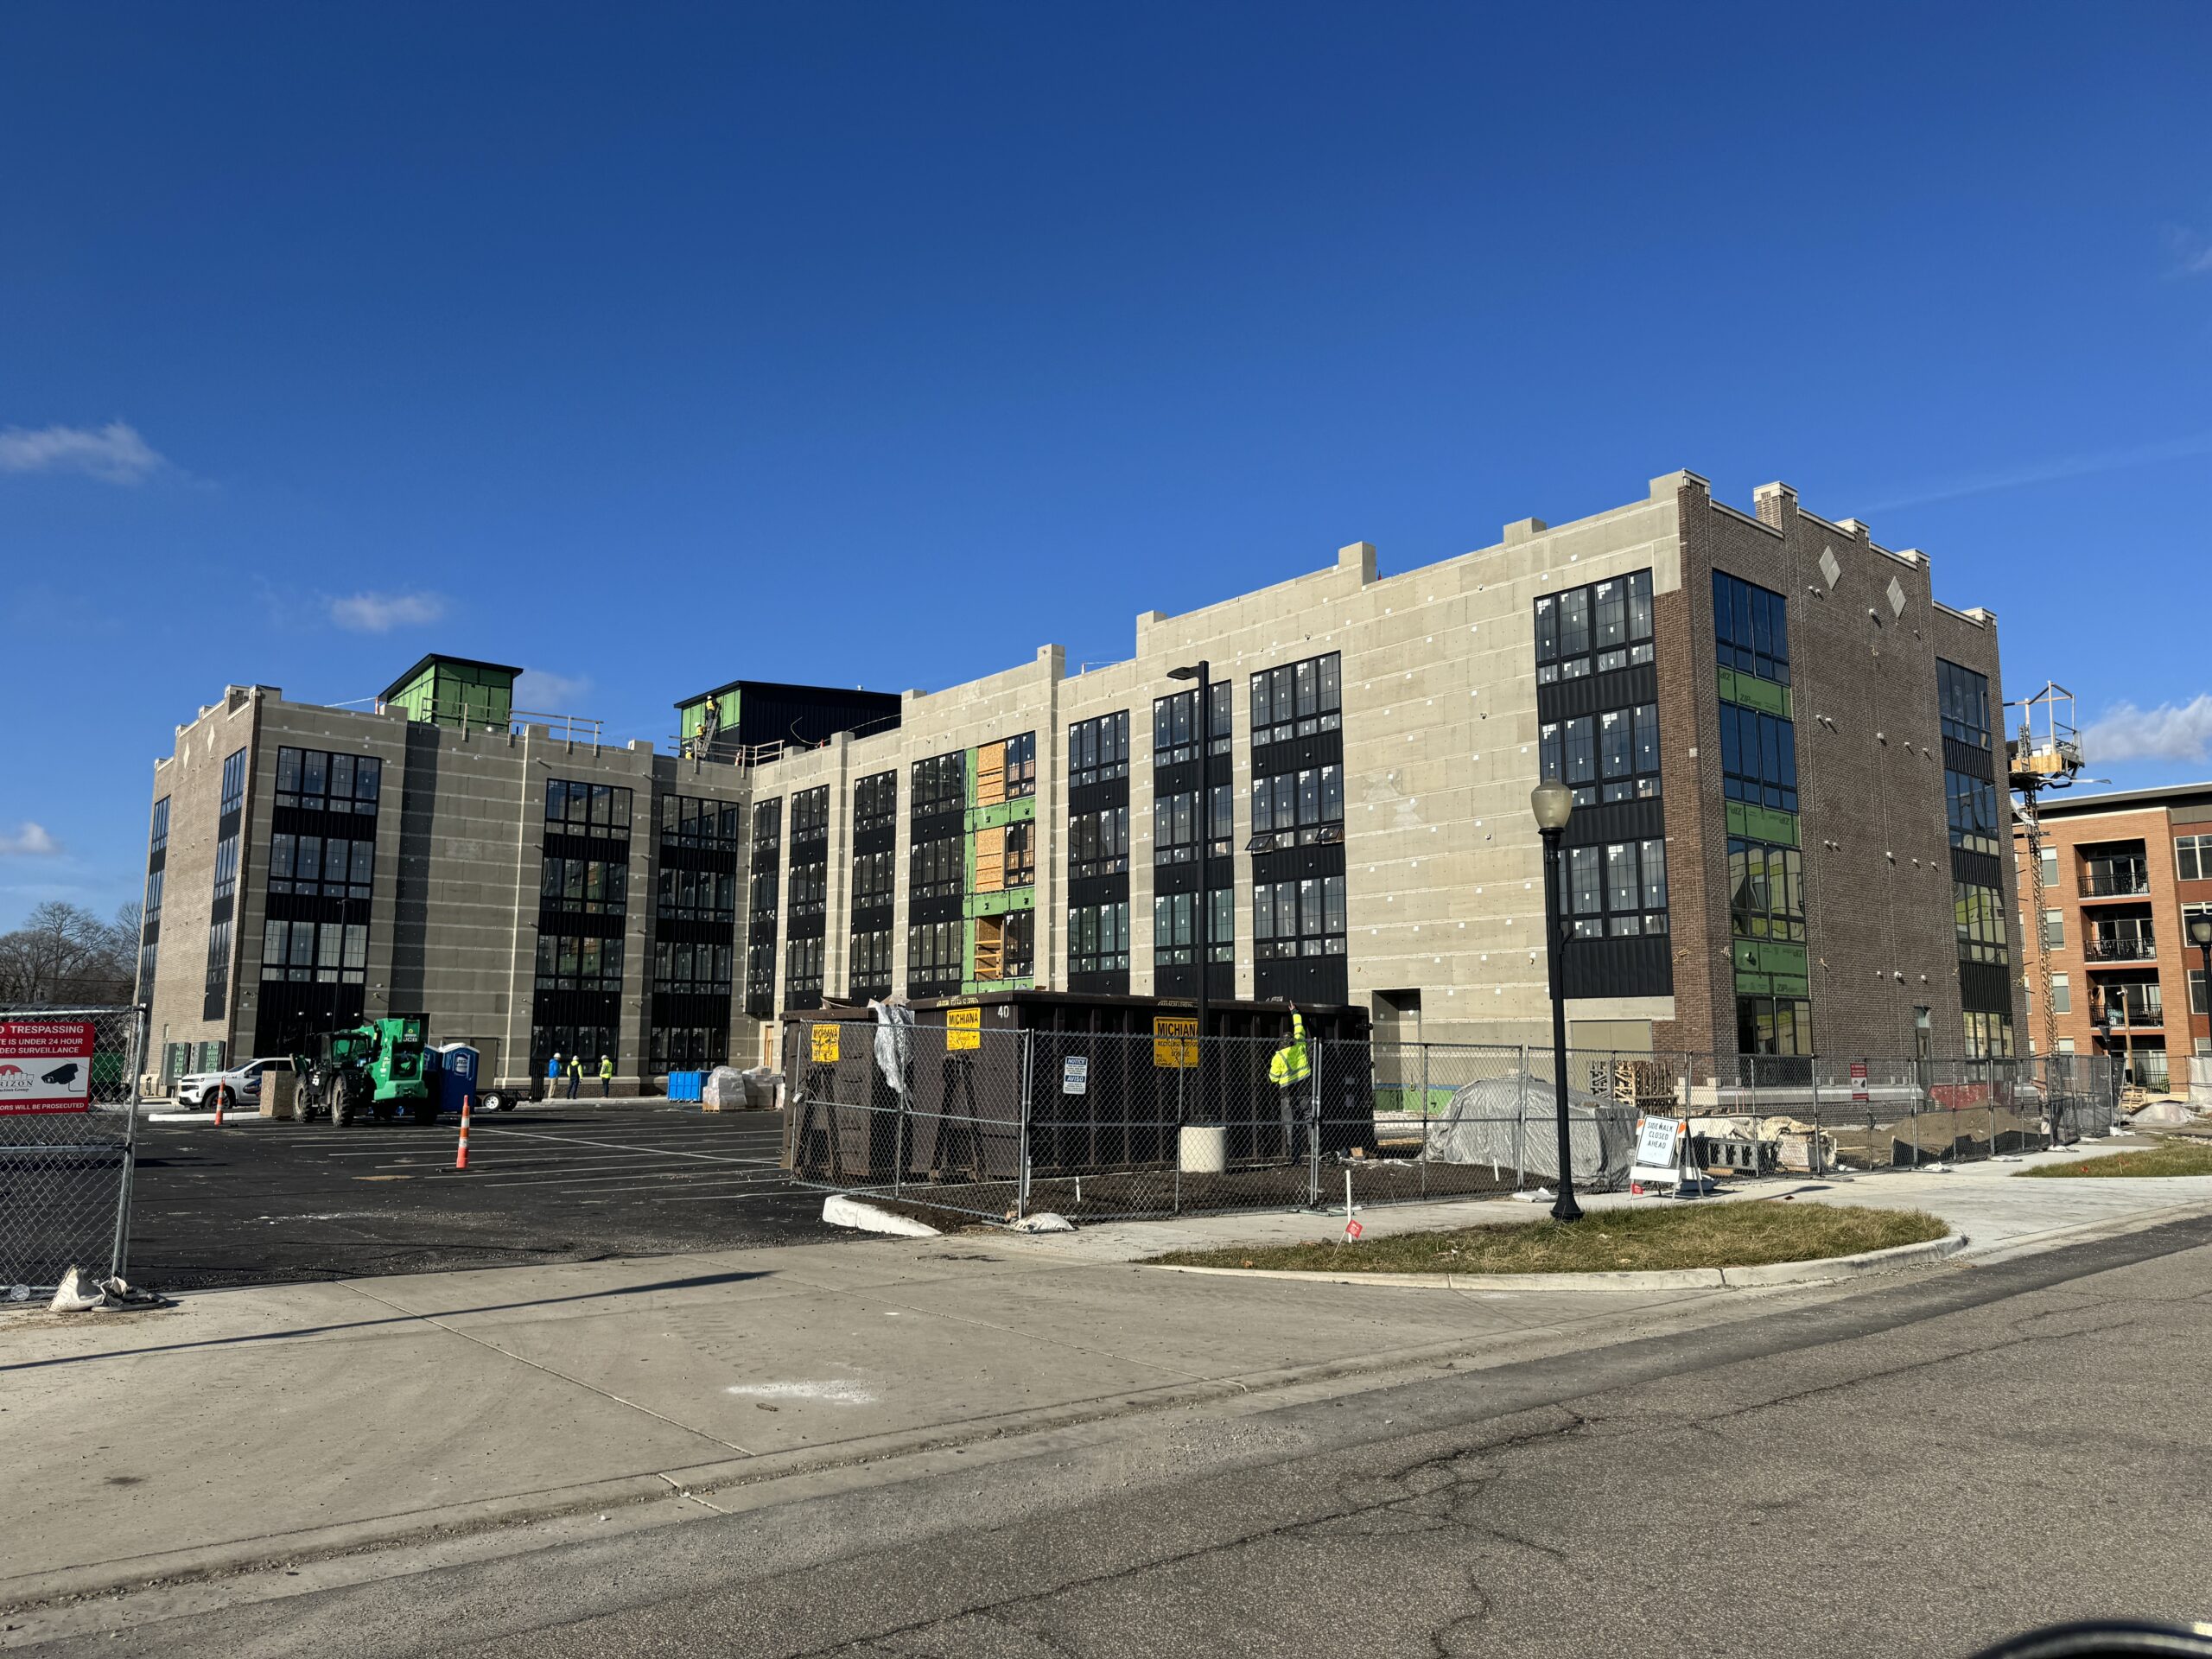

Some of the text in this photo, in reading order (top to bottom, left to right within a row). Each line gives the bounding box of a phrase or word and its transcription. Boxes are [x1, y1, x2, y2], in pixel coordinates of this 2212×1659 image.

[997, 1005, 1009, 1019] 40
[1158, 1022, 1198, 1037] MICHIAN
[1647, 1122, 1673, 1132] SIDEWALK
[1649, 1131, 1669, 1140] CLOSED
[1647, 1140, 1666, 1148] AHEAD
